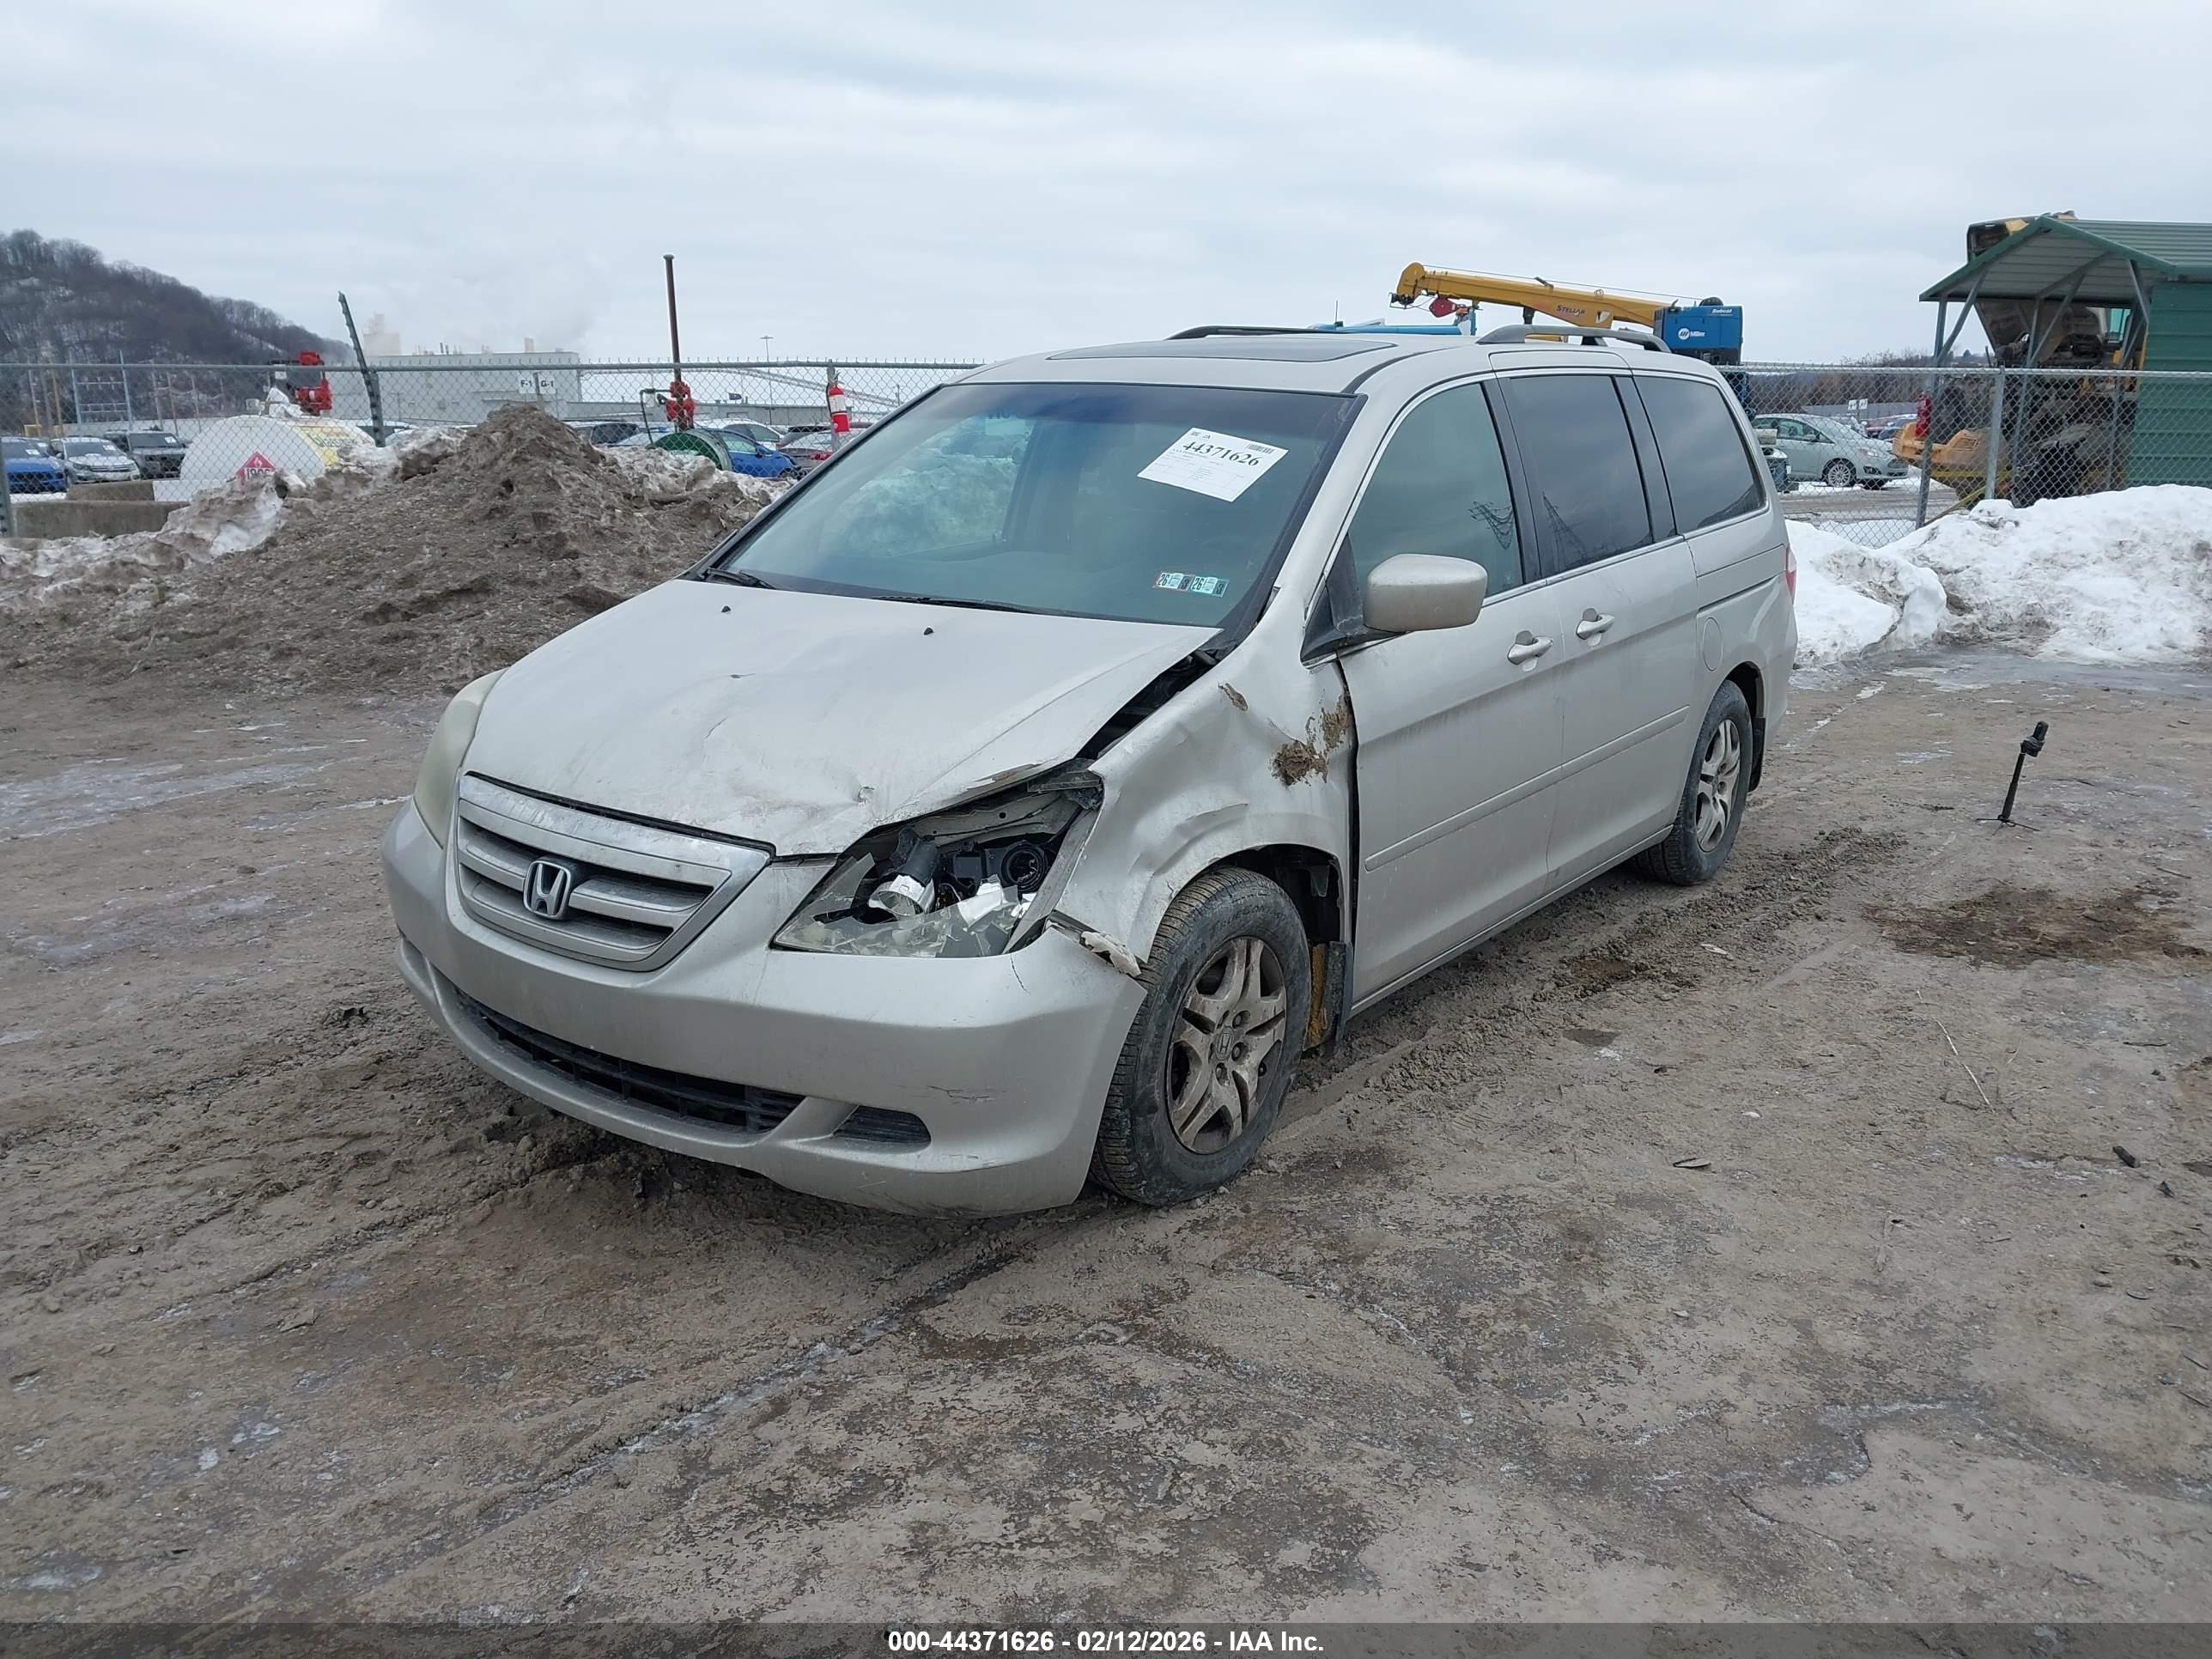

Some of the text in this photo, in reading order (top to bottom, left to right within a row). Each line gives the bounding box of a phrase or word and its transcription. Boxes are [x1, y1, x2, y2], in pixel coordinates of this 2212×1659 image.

[520, 380, 532, 388] F-1
[1182, 441, 1263, 466] 44371626
[1158, 574, 1189, 590] 26 3
[1192, 577, 1224, 595] 26 3
